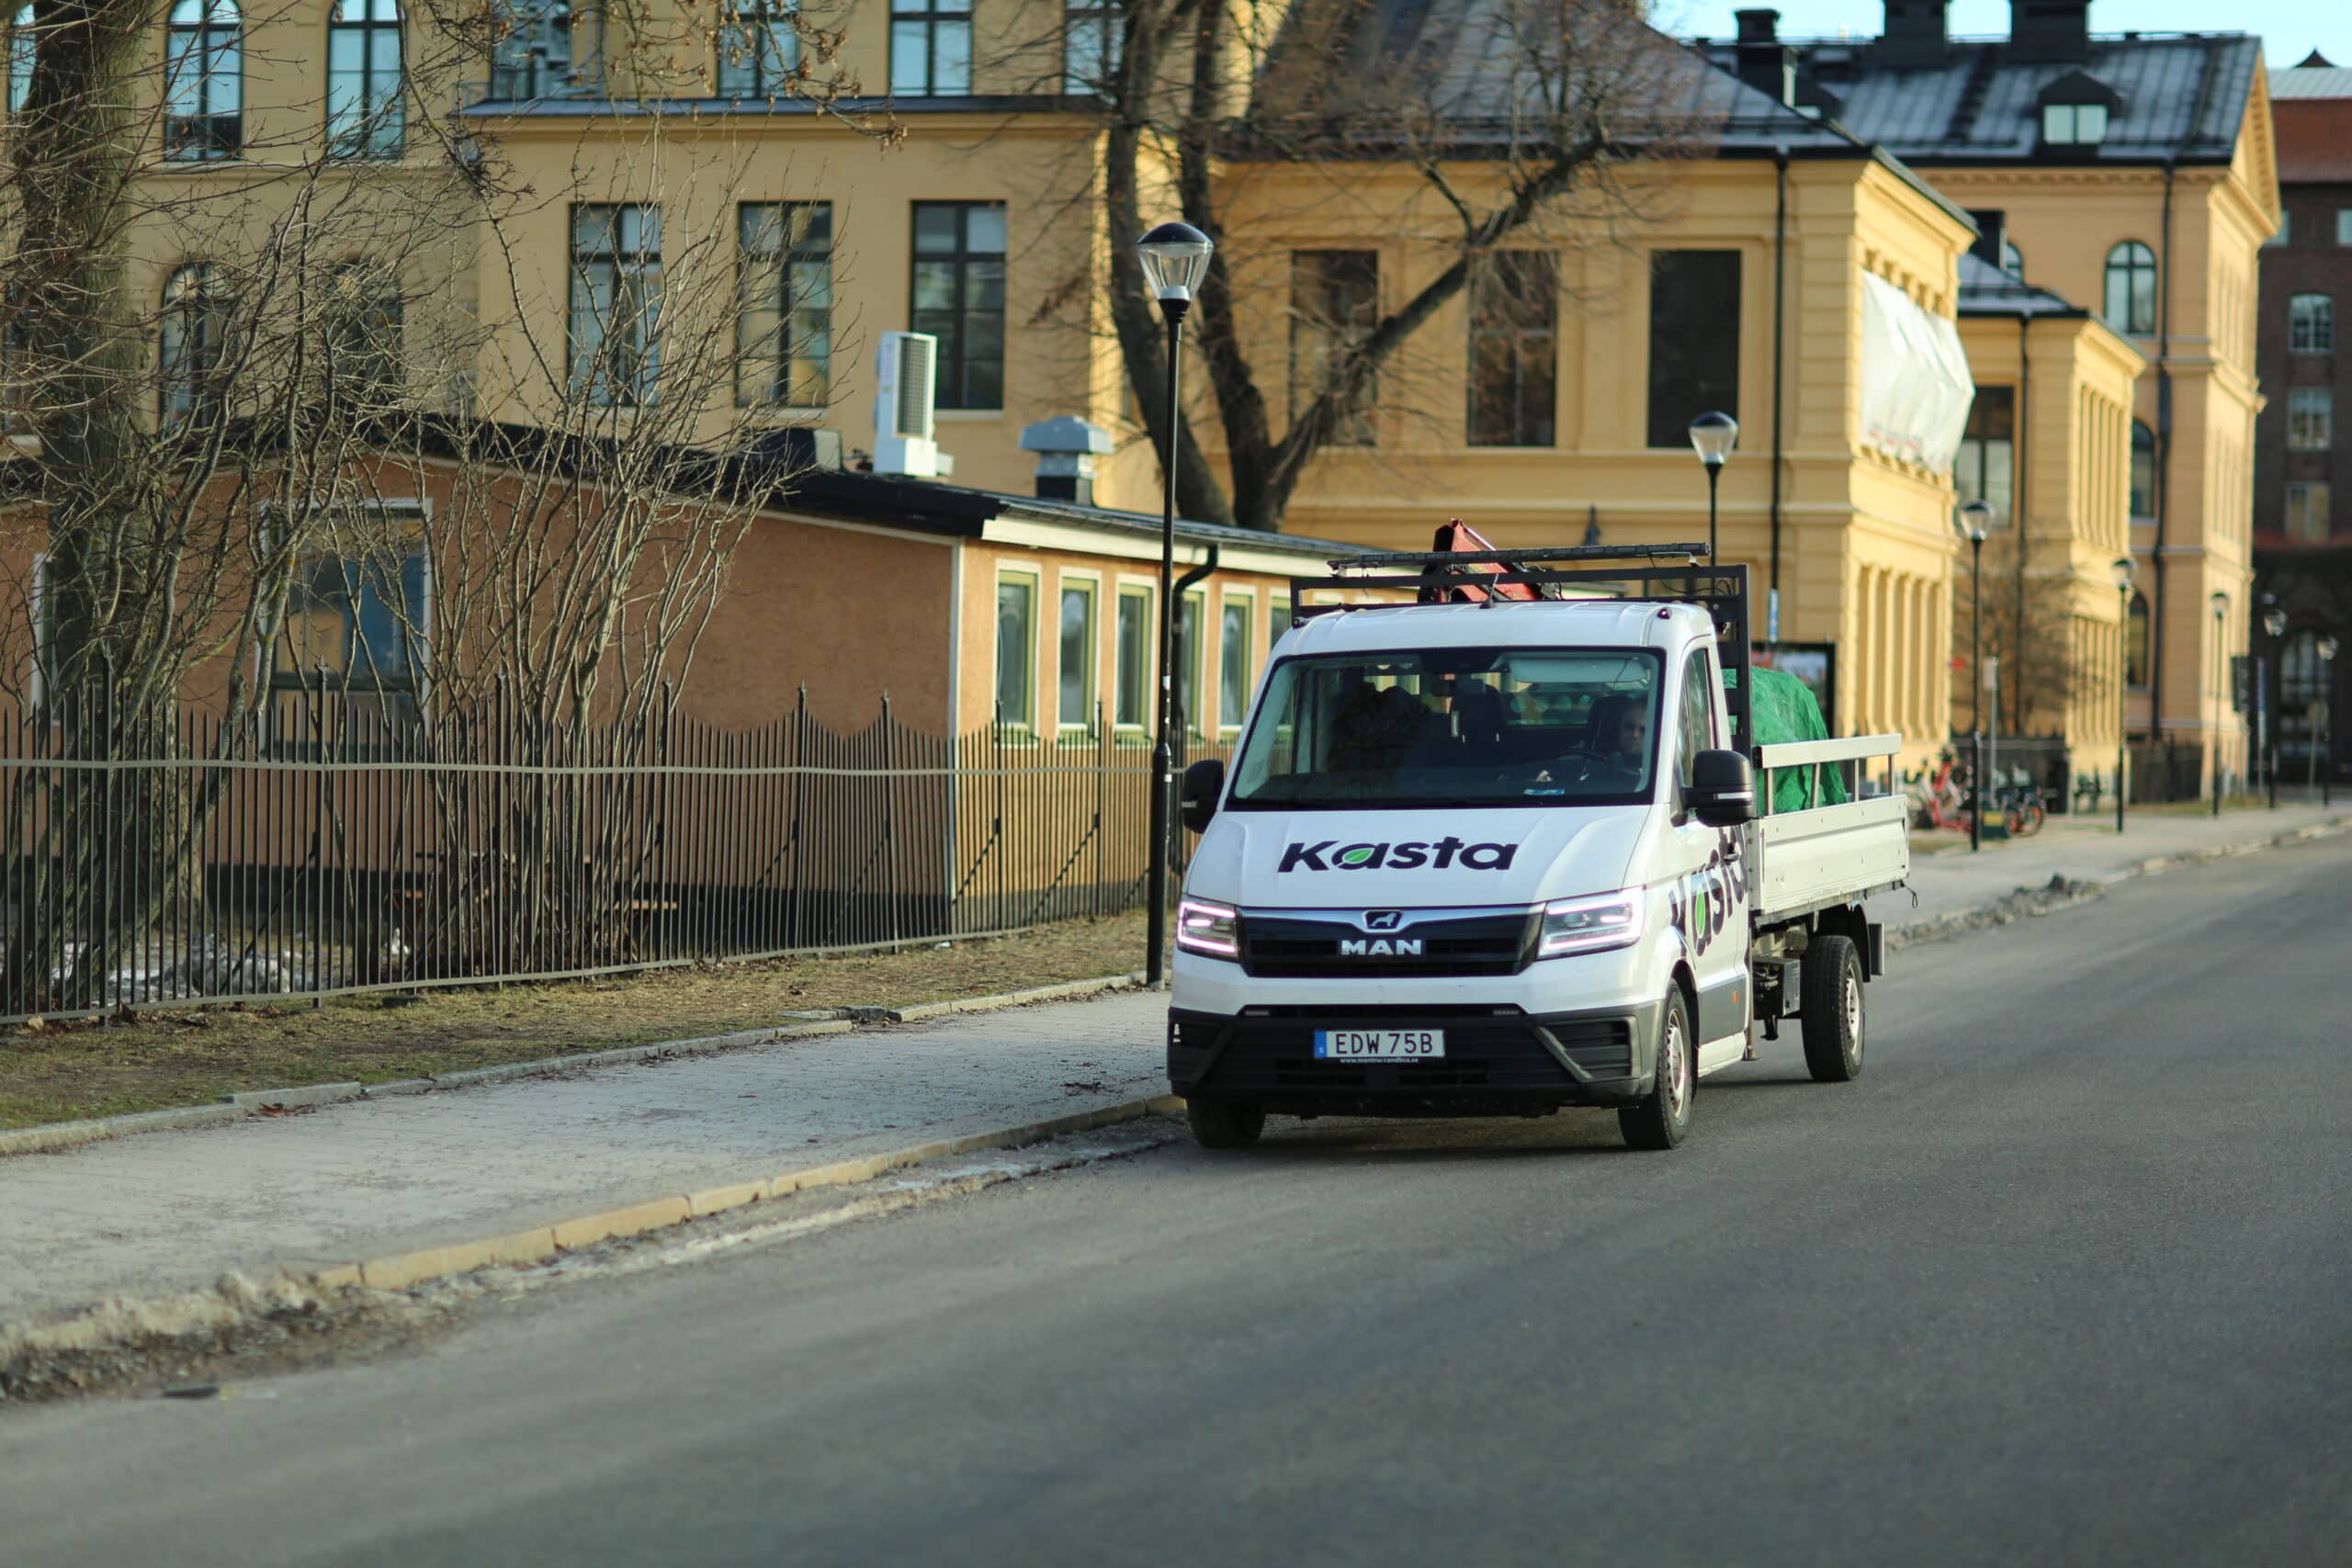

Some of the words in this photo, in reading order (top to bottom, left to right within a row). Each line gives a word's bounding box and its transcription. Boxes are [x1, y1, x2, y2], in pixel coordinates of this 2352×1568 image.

[1278, 836, 1518, 873] Kasta
[1340, 939, 1422, 955] MAN
[1335, 1032, 1379, 1055] EDW
[1388, 1032, 1433, 1055] 75B
